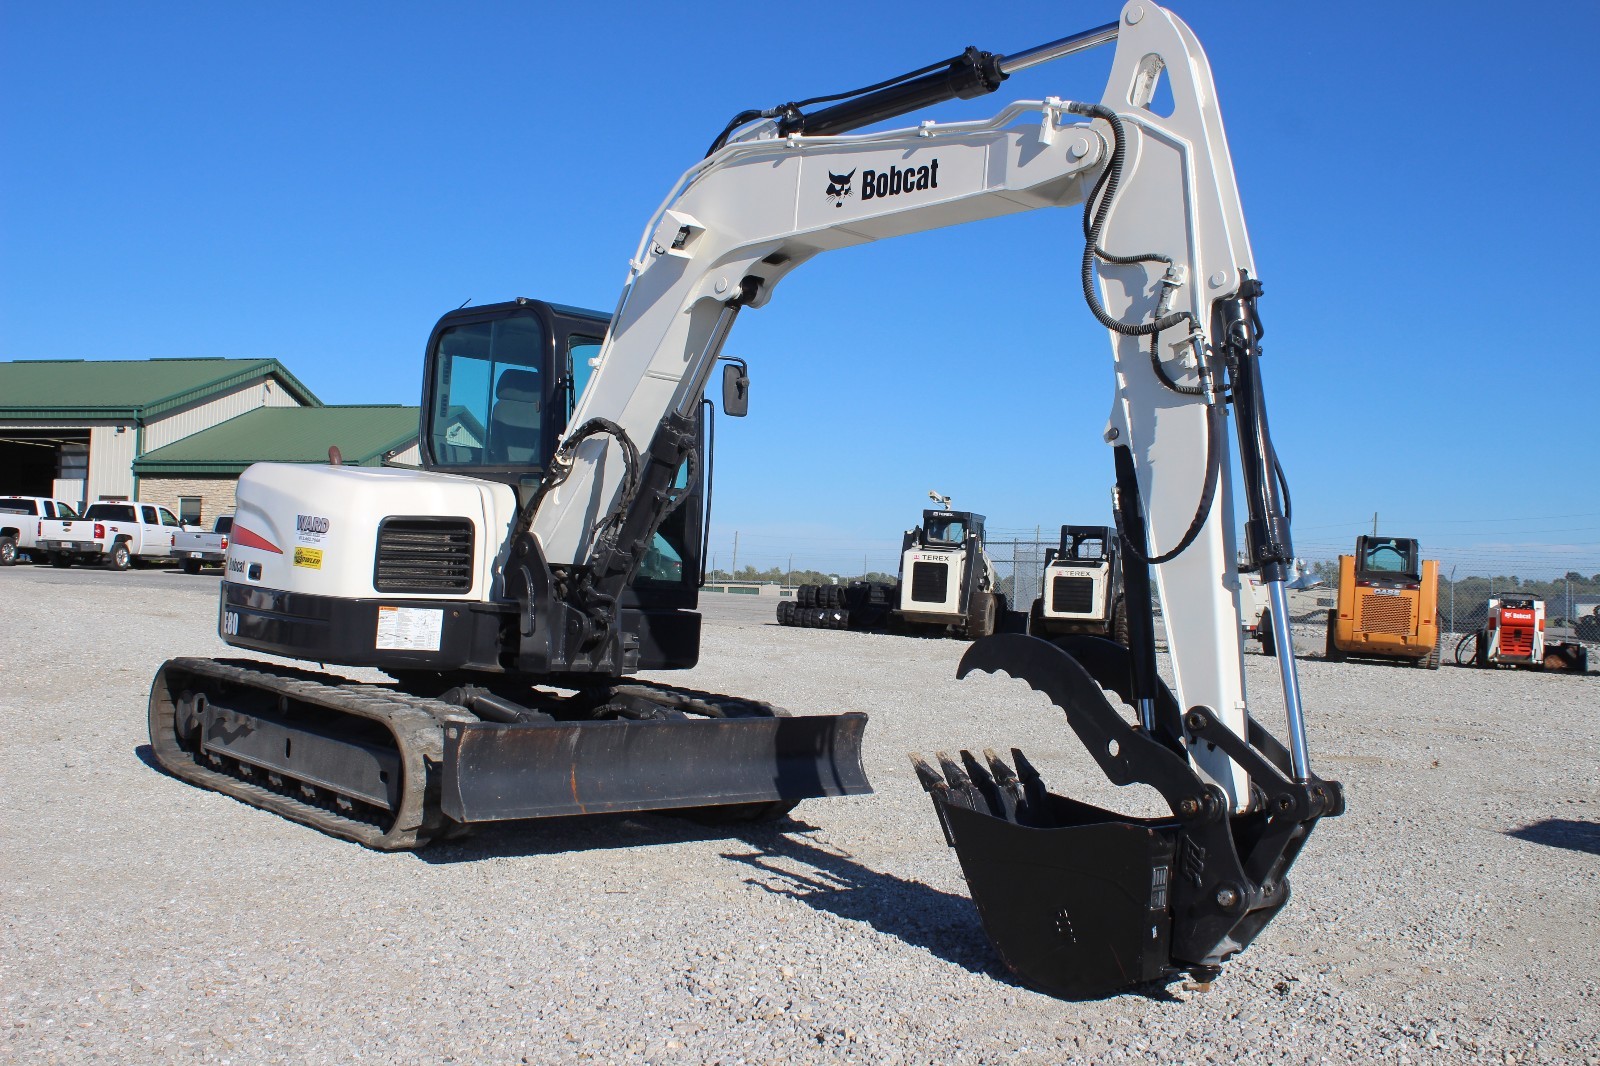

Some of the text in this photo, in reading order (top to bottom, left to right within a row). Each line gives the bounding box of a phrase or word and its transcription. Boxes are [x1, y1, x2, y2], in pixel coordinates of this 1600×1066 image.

[861, 159, 938, 200] Bobcat
[297, 514, 330, 533] WARD
[223, 611, 239, 636] E80
[1512, 612, 1532, 620] Bobcat
